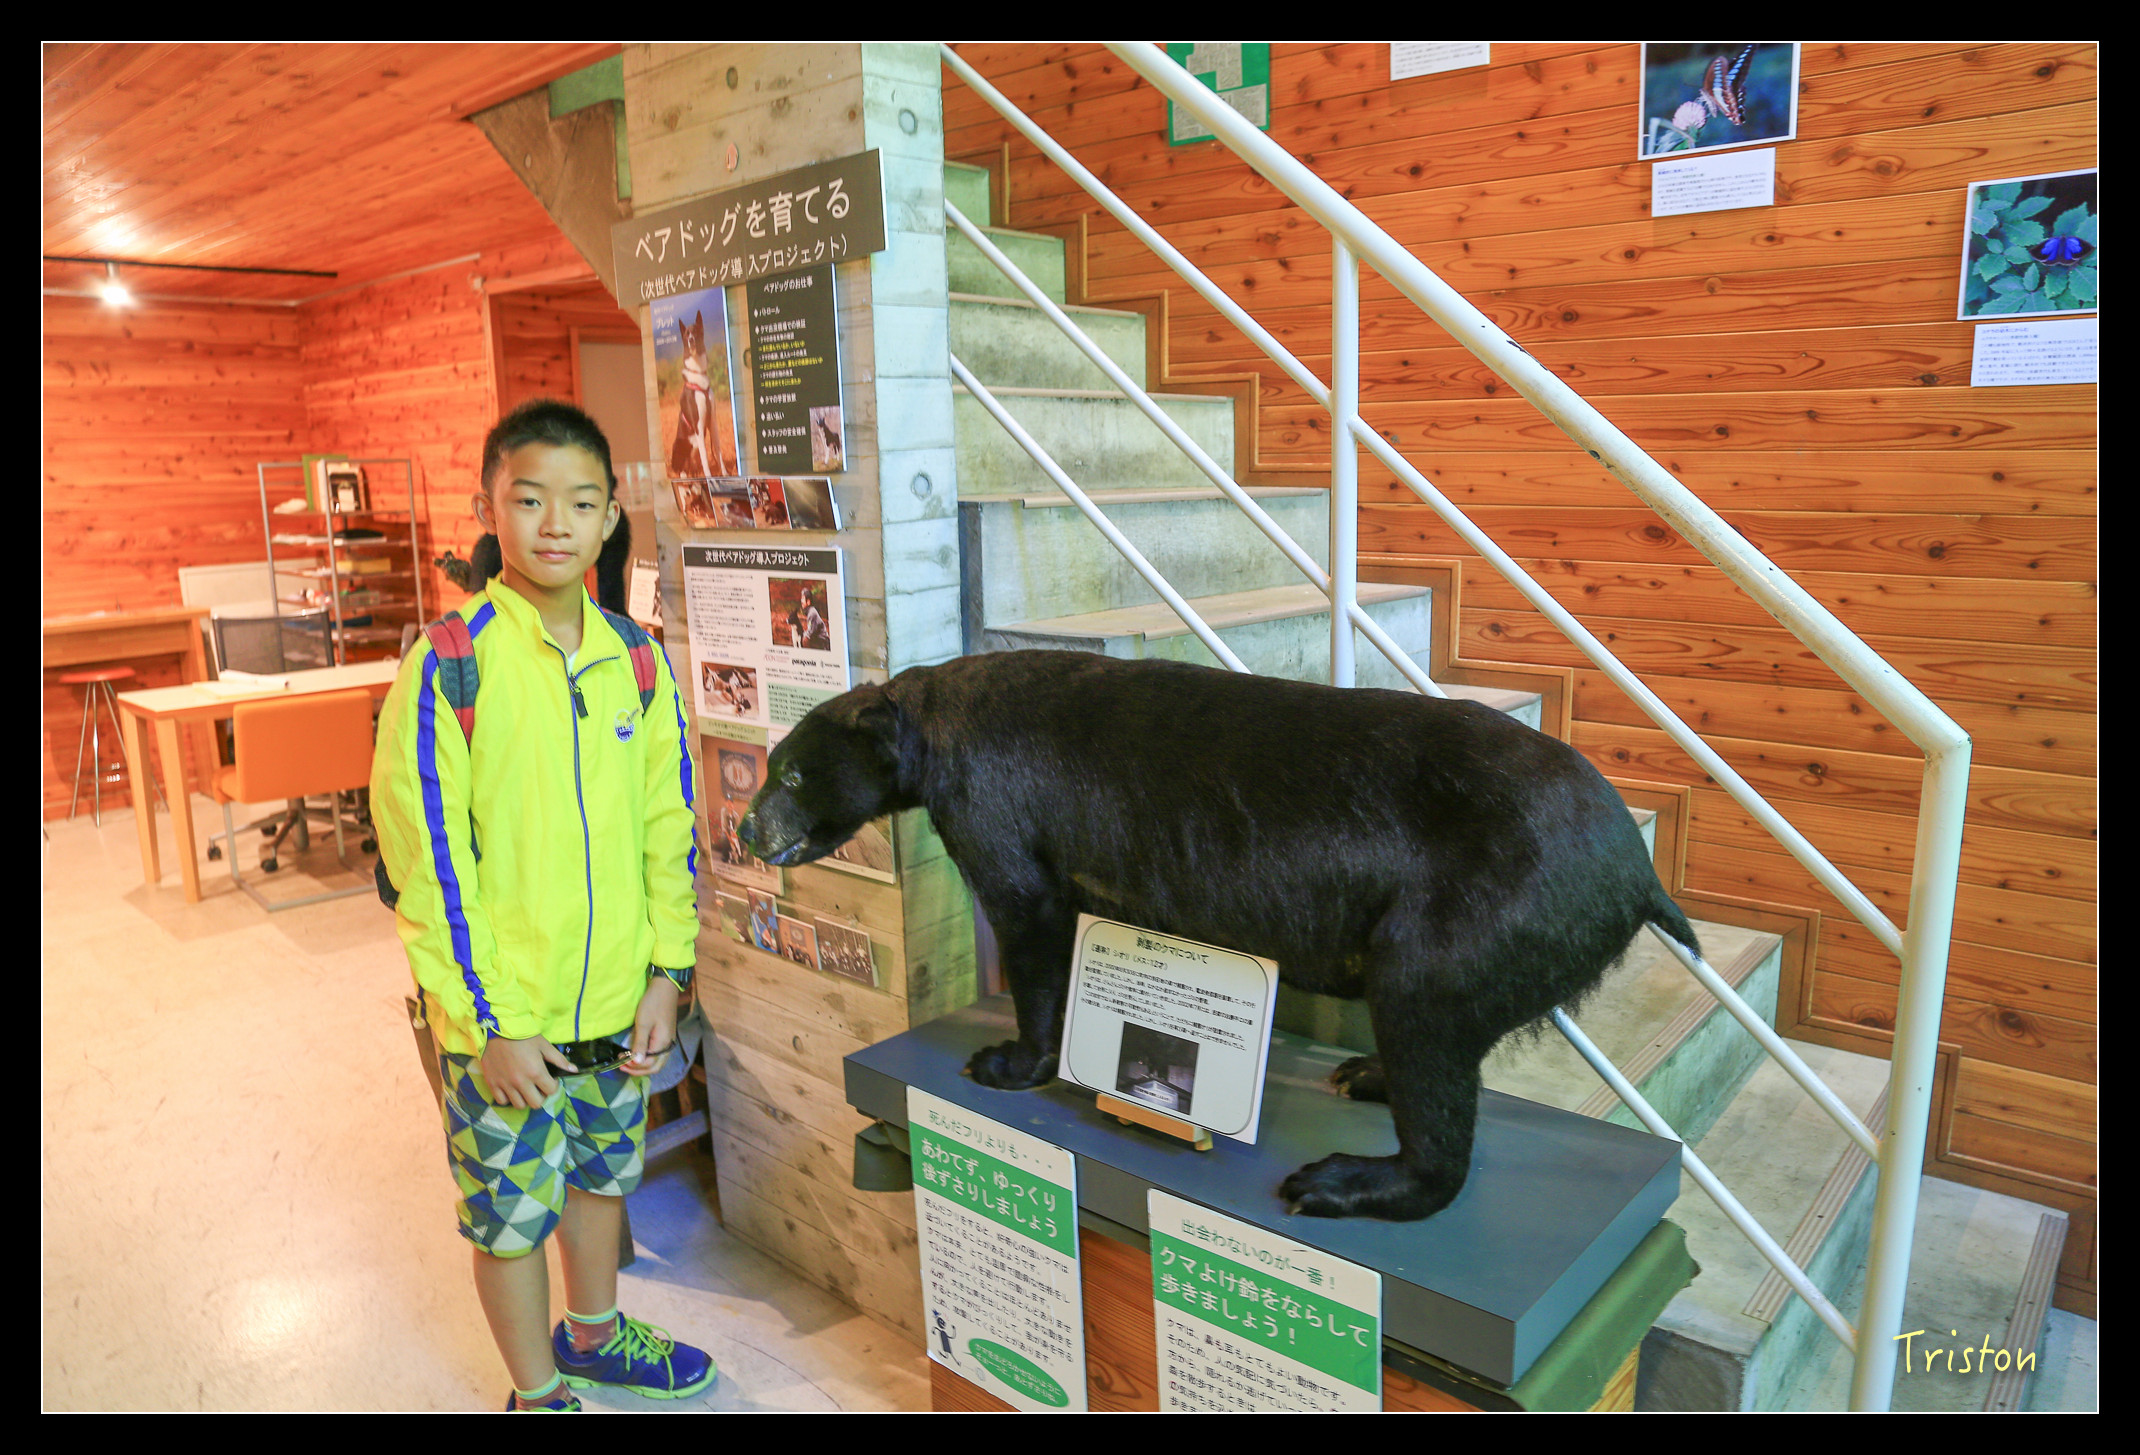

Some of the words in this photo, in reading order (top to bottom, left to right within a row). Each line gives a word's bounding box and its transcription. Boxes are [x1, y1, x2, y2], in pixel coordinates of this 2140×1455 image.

[635, 177, 850, 264] ベアドッグを育てる
[705, 550, 810, 567] 次世代ベアドッグ導入プロジェクト
[921, 1138, 1056, 1213] あわてず、ゆっくり
[921, 1161, 1058, 1238] 後ずさりしましょう
[1181, 1218, 1336, 1290] 出会わないのが一番！
[1160, 1246, 1370, 1348] クマよけ鈴をならして
[1160, 1272, 1296, 1345] 歩きましょう！
